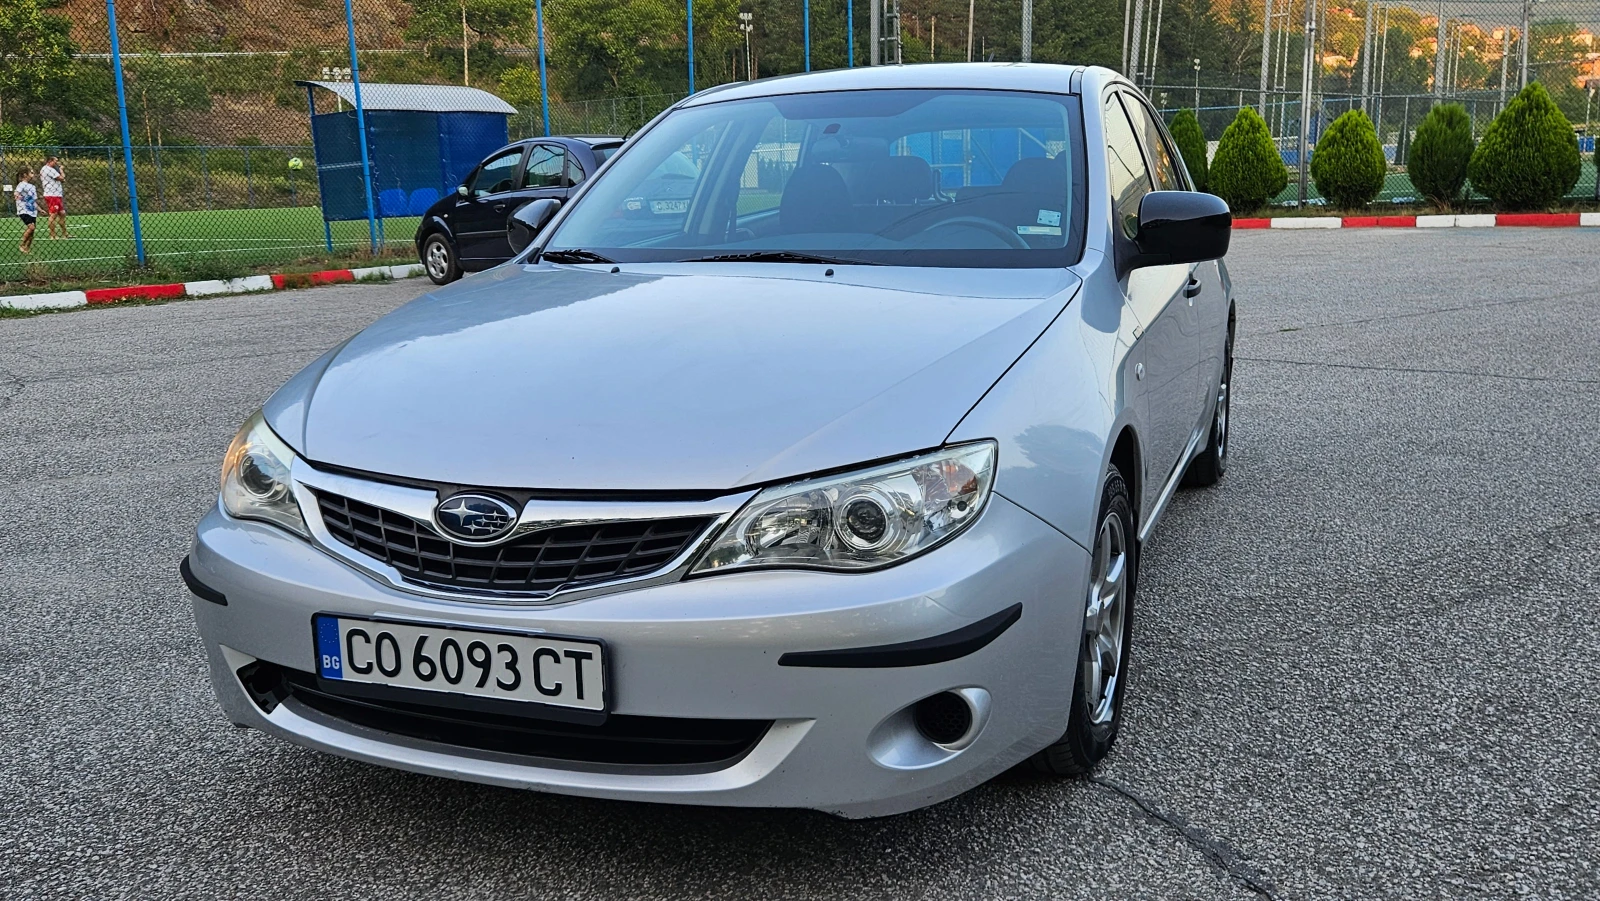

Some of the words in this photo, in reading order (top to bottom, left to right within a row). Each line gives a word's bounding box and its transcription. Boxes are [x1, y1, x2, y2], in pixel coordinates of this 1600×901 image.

[322, 654, 340, 670] BG
[346, 628, 401, 677] CO
[413, 635, 522, 691] 6093
[533, 647, 593, 700] CT
